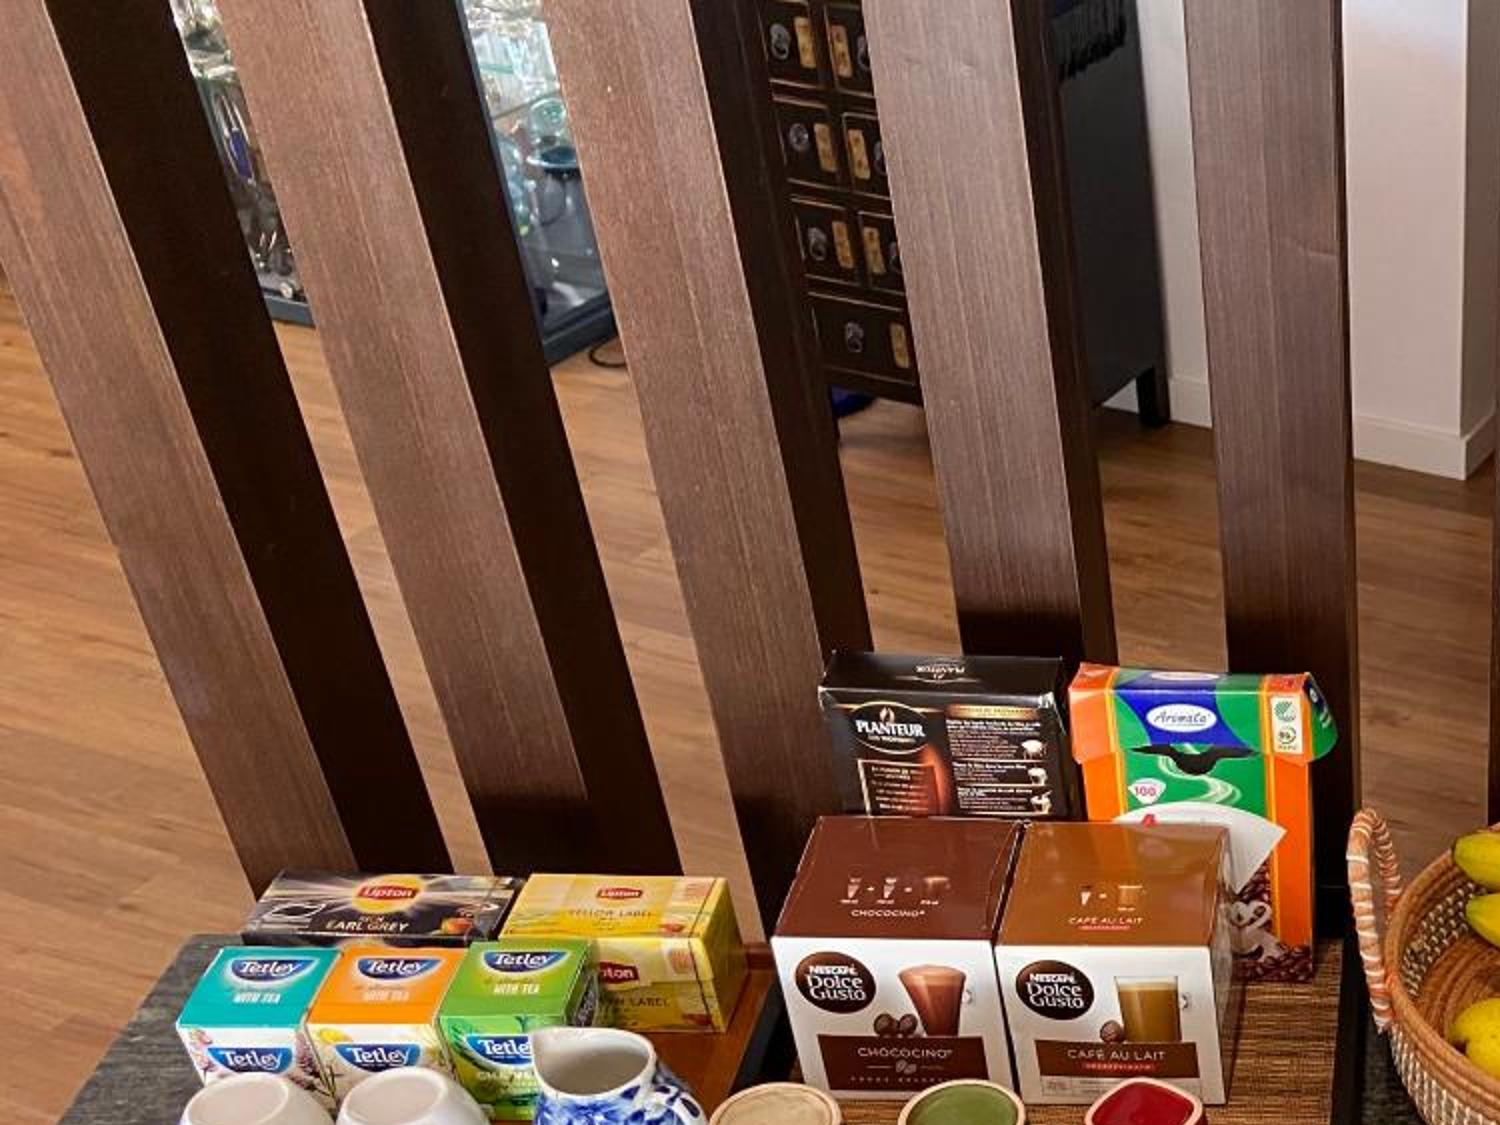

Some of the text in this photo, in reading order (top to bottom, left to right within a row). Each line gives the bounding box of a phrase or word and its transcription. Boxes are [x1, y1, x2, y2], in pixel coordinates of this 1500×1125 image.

[855, 719, 926, 737] PLANTEUR
[362, 886, 413, 900] Lipton
[600, 888, 641, 899] Lipton
[326, 921, 409, 931] EARL GREY
[240, 960, 301, 977] Tetley
[367, 959, 429, 977] Tetley
[495, 953, 554, 968] Tetley
[807, 974, 863, 990] Dolce
[1026, 982, 1083, 998] Dolce
[810, 986, 866, 1001] Gusto
[1029, 994, 1085, 1009] Gusto
[347, 1047, 412, 1067] Tetley
[478, 1039, 533, 1059] Tetle
[1110, 1050, 1130, 1061] AU
[1134, 1051, 1166, 1061] LAIT
[220, 1050, 284, 1071] Tetley
